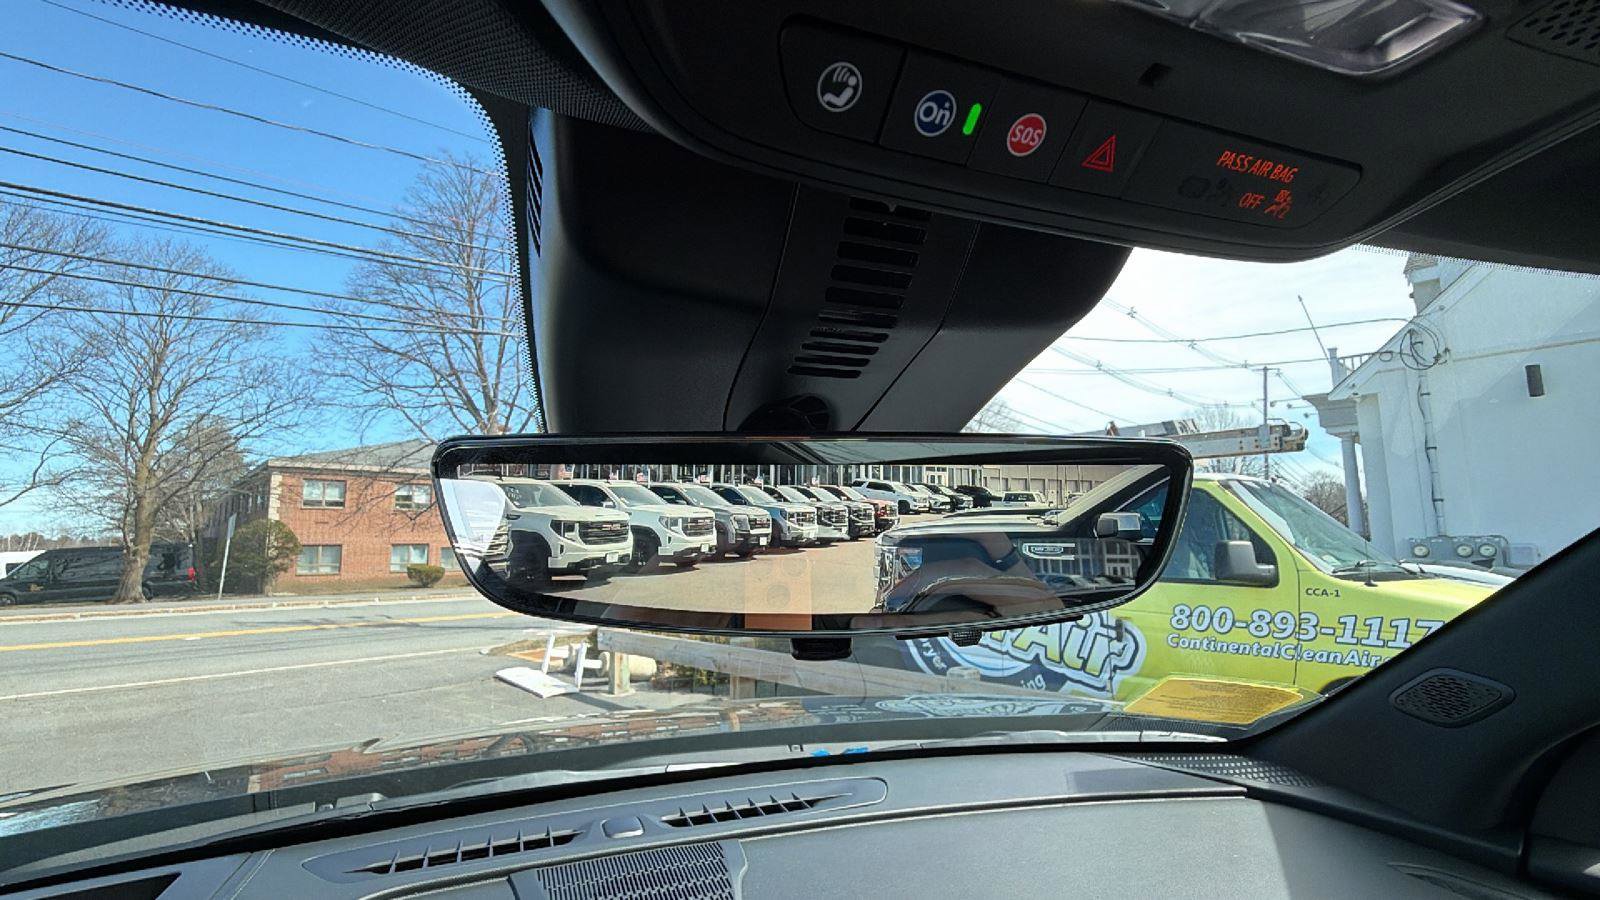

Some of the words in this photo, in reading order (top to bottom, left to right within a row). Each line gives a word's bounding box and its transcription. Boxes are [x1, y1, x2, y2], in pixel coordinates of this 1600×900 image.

[919, 101, 951, 127] On
[1011, 124, 1043, 146] SOS
[1216, 150, 1253, 172] PASS
[1248, 159, 1274, 178] AIR
[1270, 164, 1299, 183] BAG
[1239, 192, 1265, 209] OFF
[1305, 587, 1341, 597] CCA-1
[1166, 632, 1391, 668] ContinentalCleanAir
